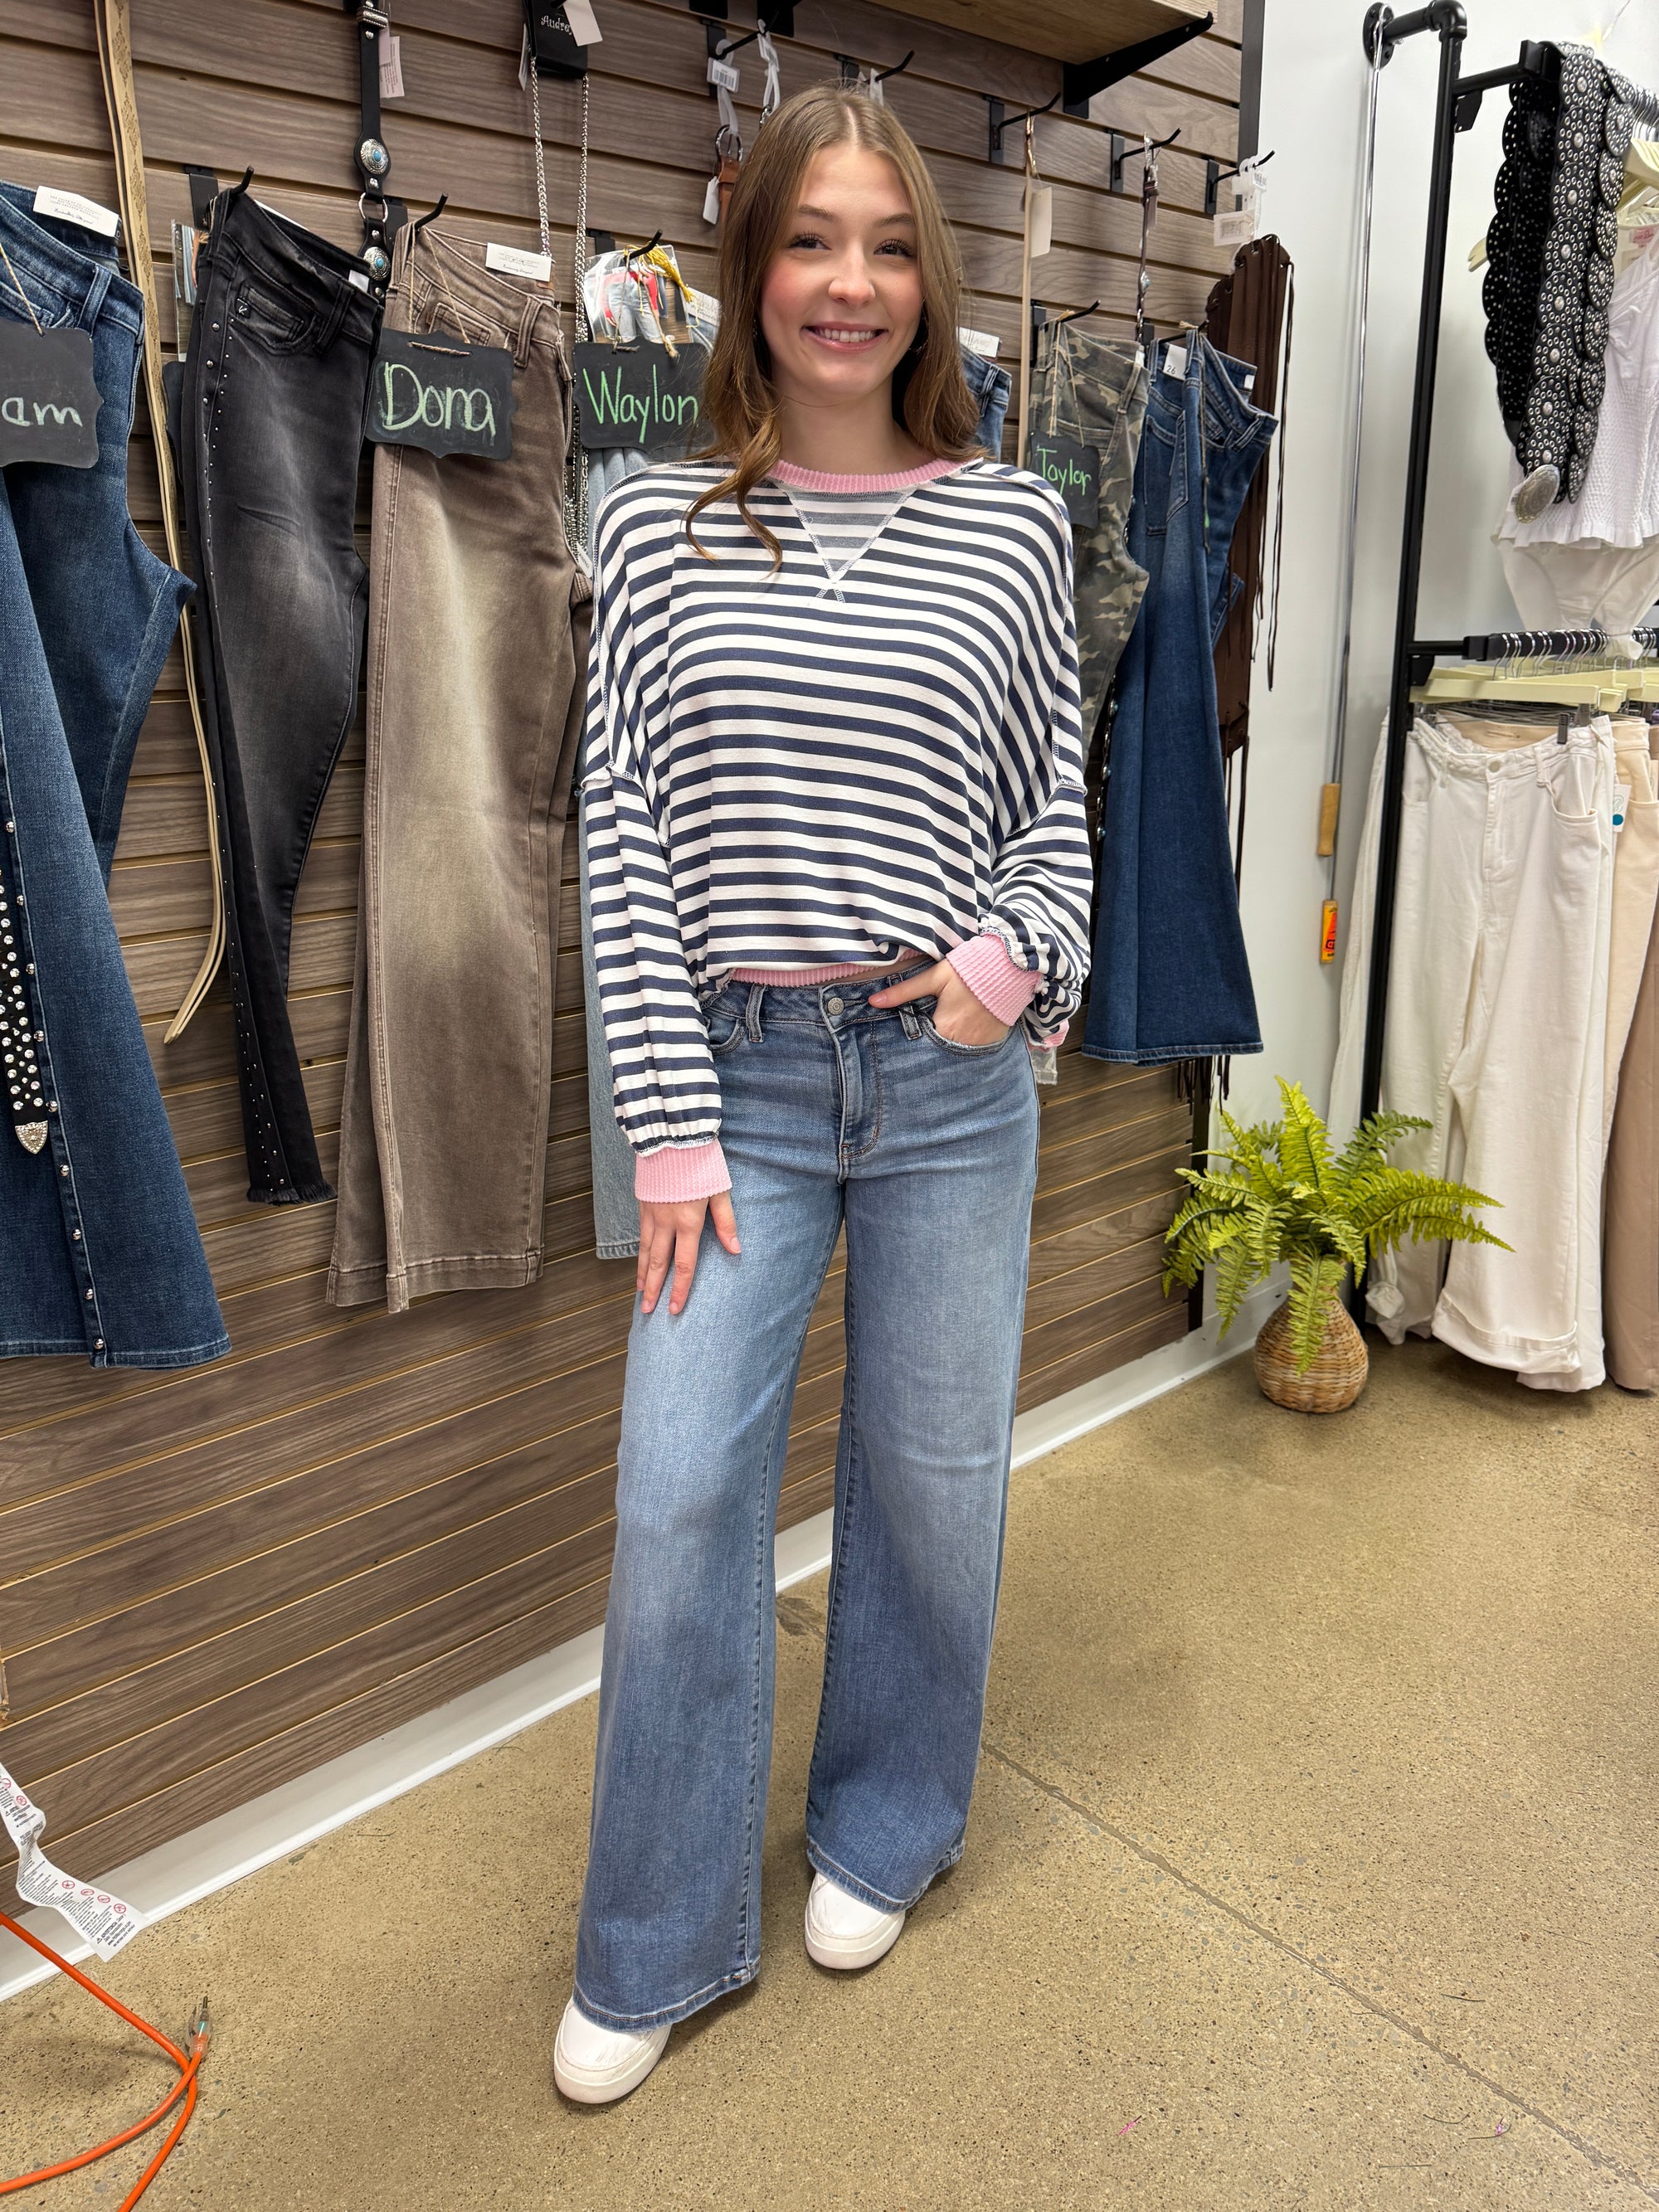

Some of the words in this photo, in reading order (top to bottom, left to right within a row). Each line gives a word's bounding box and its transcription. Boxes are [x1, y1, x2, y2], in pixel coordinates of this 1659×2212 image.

[541, 15, 572, 35] Audre
[1166, 365, 1176, 374] 26
[582, 363, 698, 444] Waylon
[1036, 448, 1092, 496] Taylor
